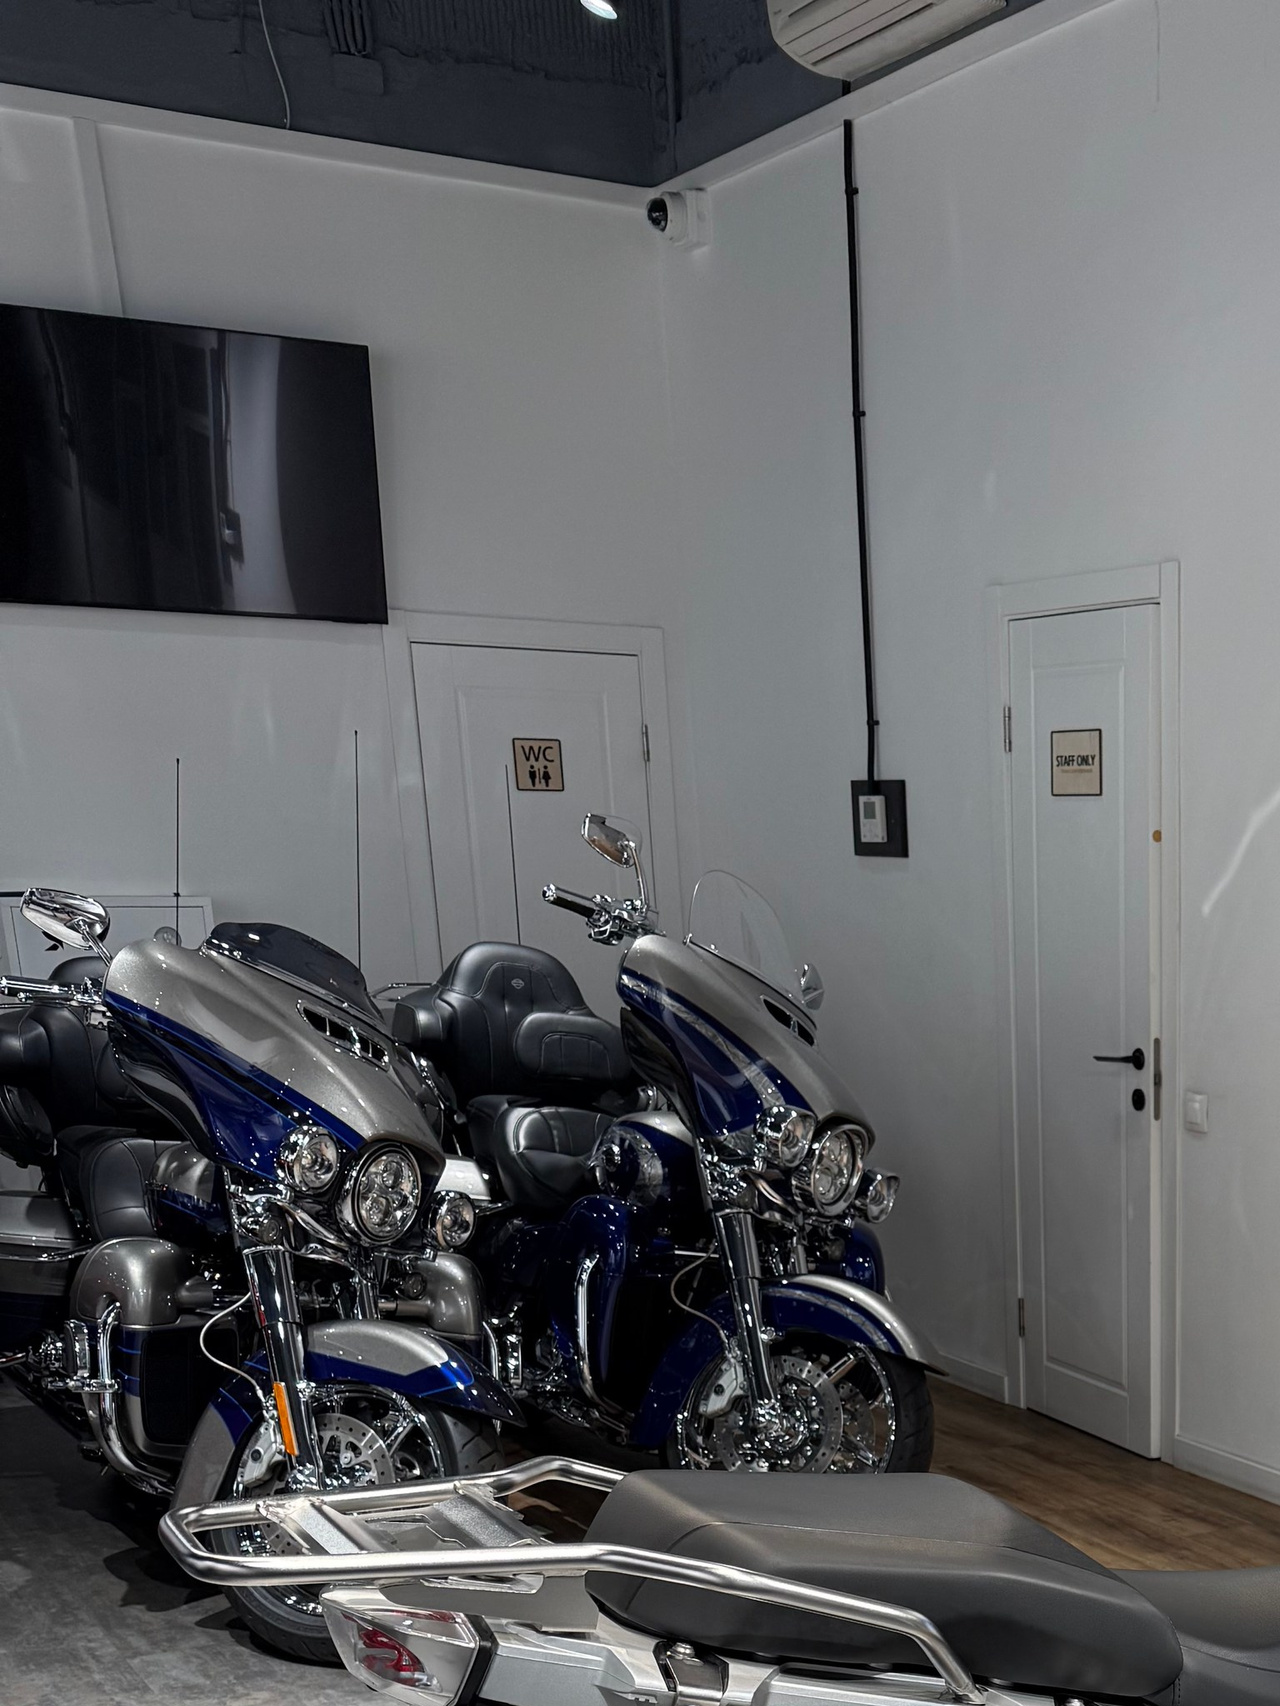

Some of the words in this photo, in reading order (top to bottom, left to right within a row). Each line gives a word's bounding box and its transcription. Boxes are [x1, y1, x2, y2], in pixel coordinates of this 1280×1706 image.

[521, 745, 555, 763] WC
[1056, 755, 1076, 767] STAFF
[1076, 754, 1096, 766] ONLY
